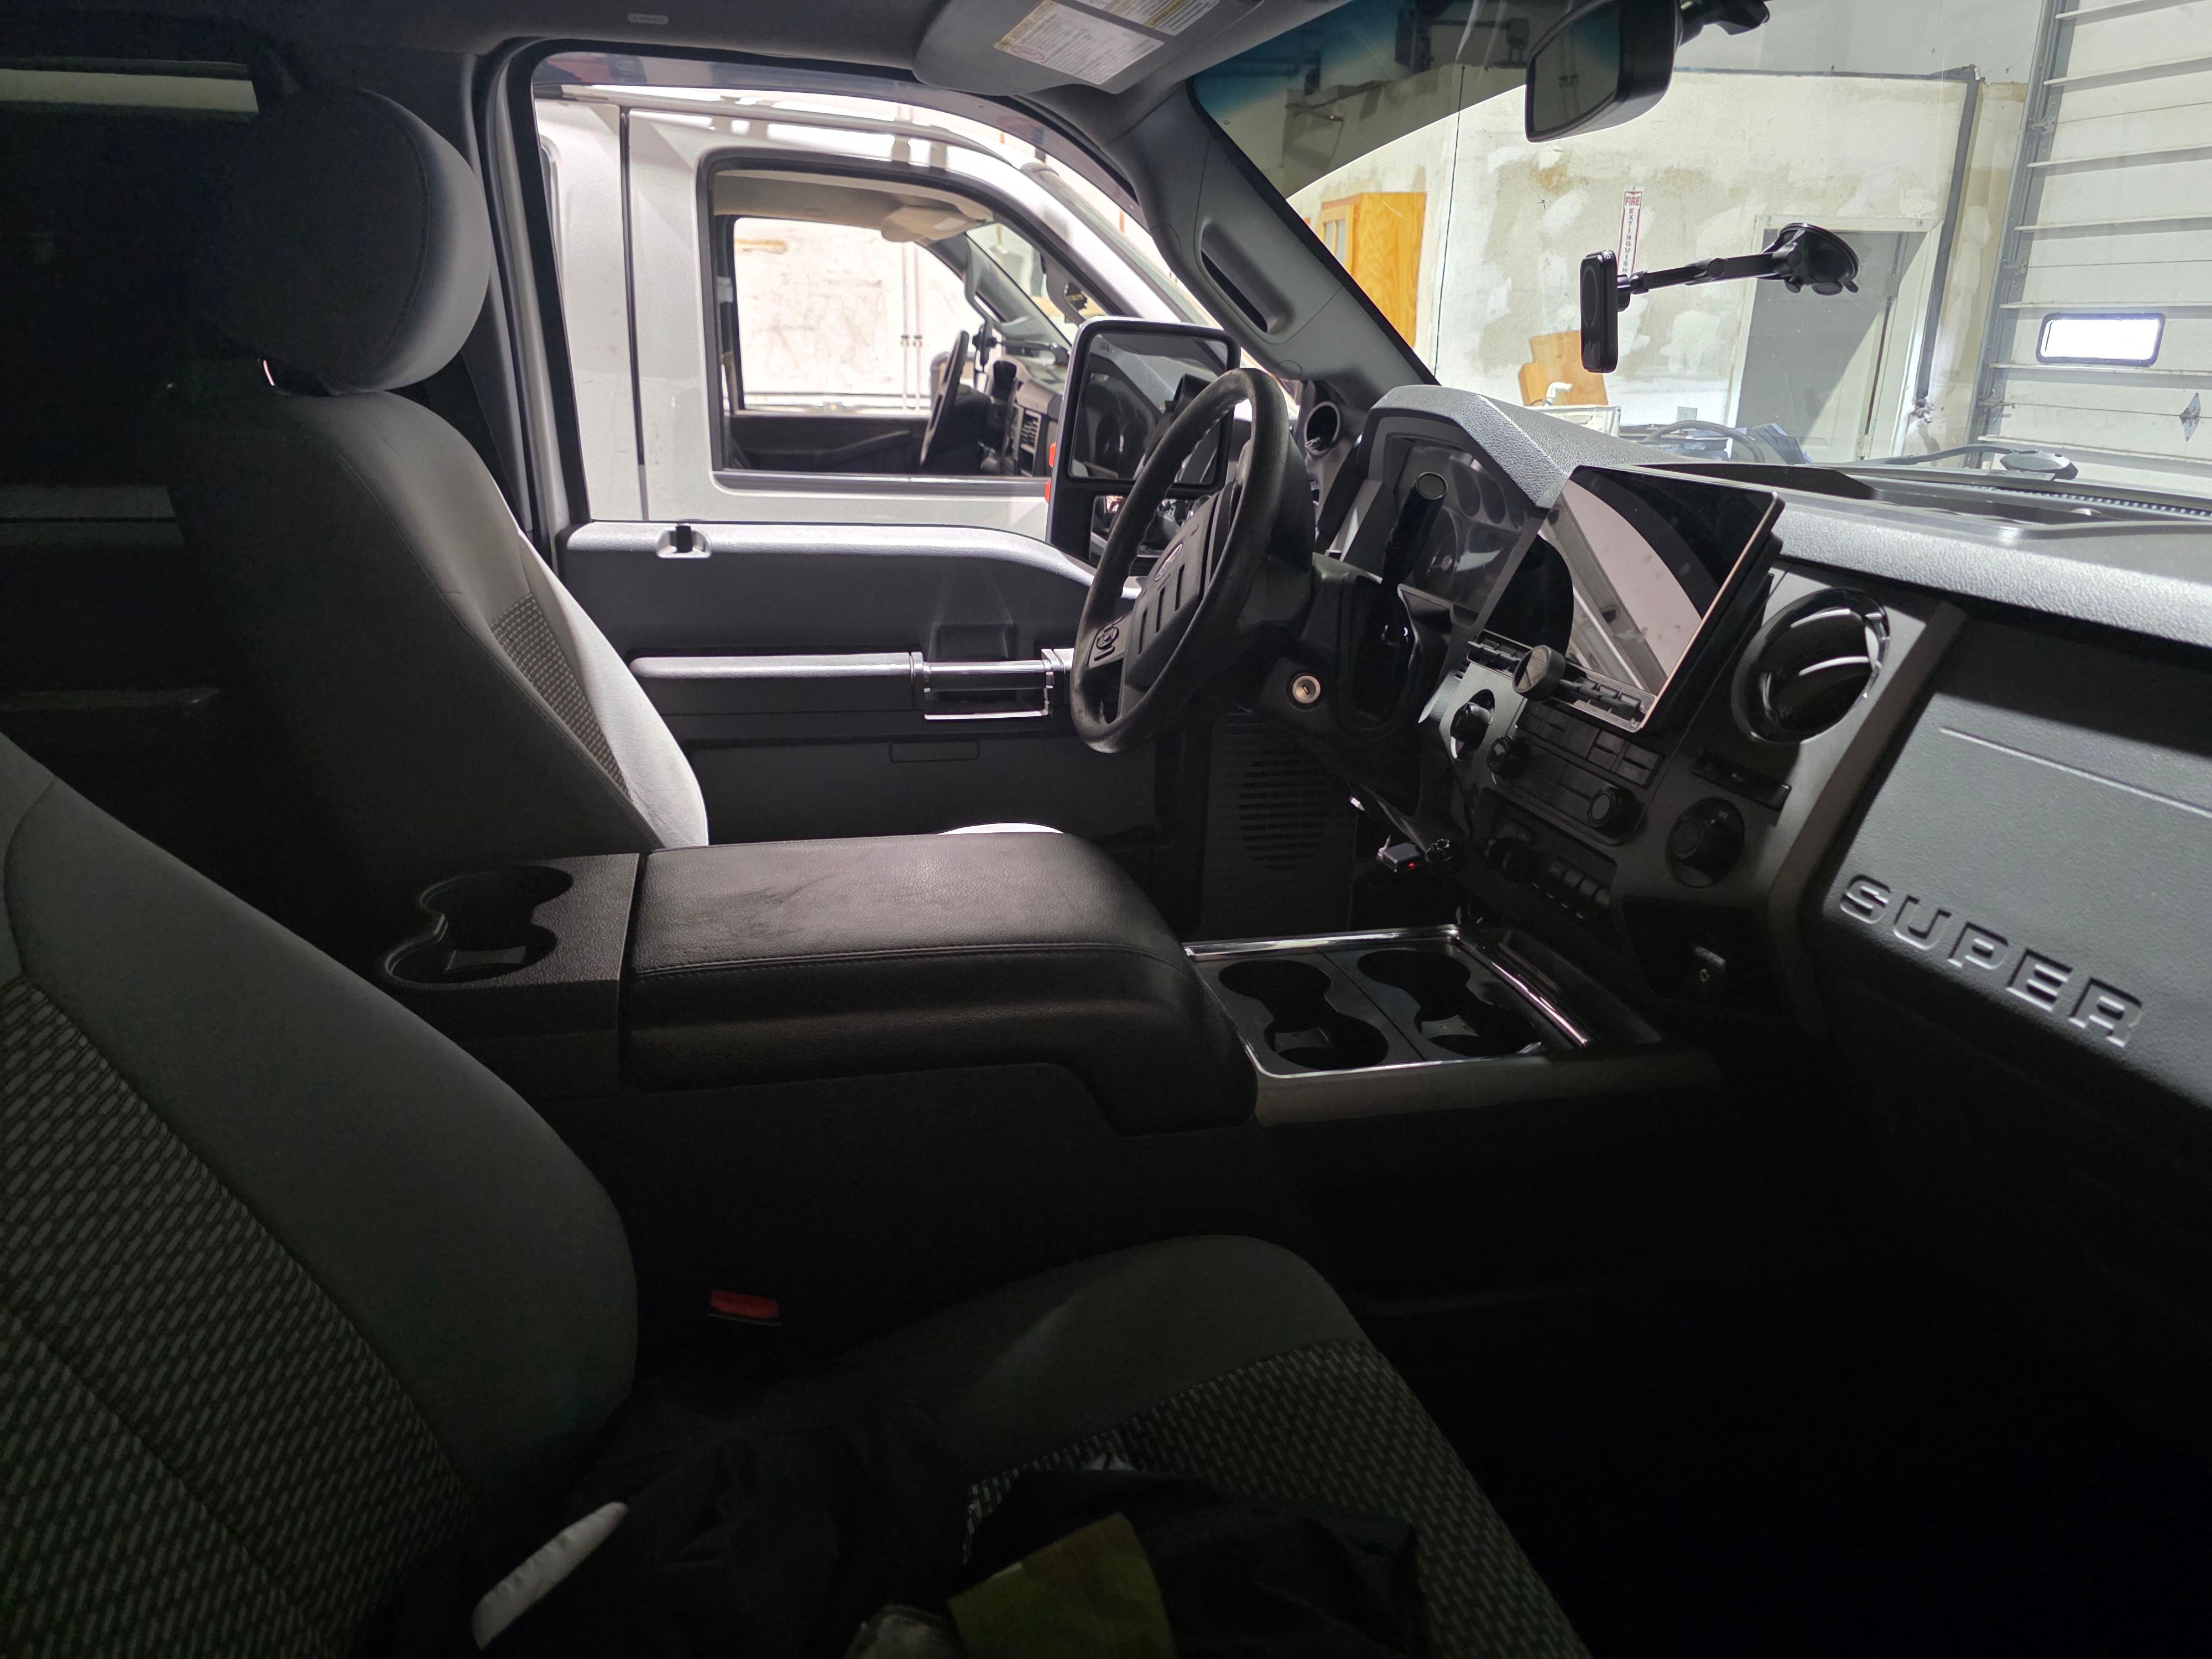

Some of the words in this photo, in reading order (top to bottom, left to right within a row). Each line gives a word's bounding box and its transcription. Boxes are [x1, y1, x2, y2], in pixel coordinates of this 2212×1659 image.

[1625, 197, 1640, 206] FIRE
[1623, 208, 1634, 273] EXTINGUISH
[1840, 874, 2143, 1048] SUPER
